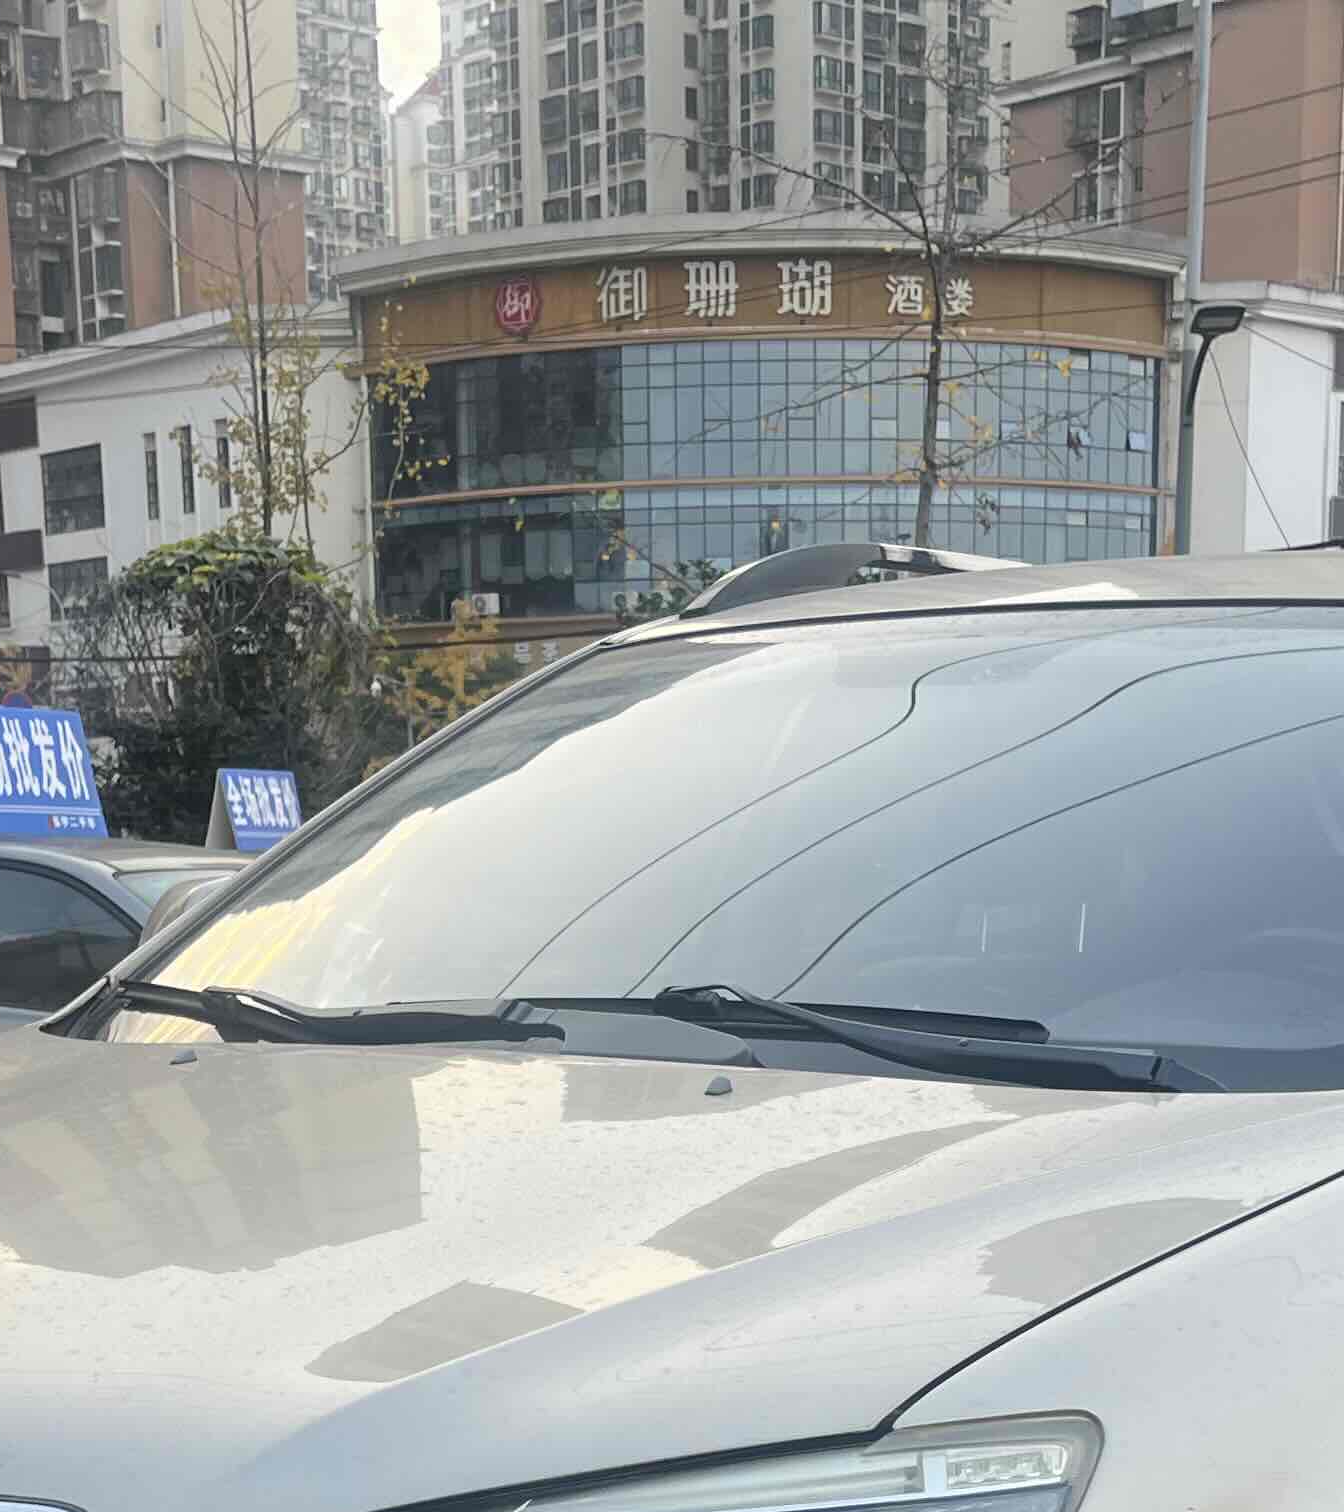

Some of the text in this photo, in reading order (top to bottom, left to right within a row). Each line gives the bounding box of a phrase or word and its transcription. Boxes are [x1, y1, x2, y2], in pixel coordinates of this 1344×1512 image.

[226, 774, 302, 830] 全场批发价
